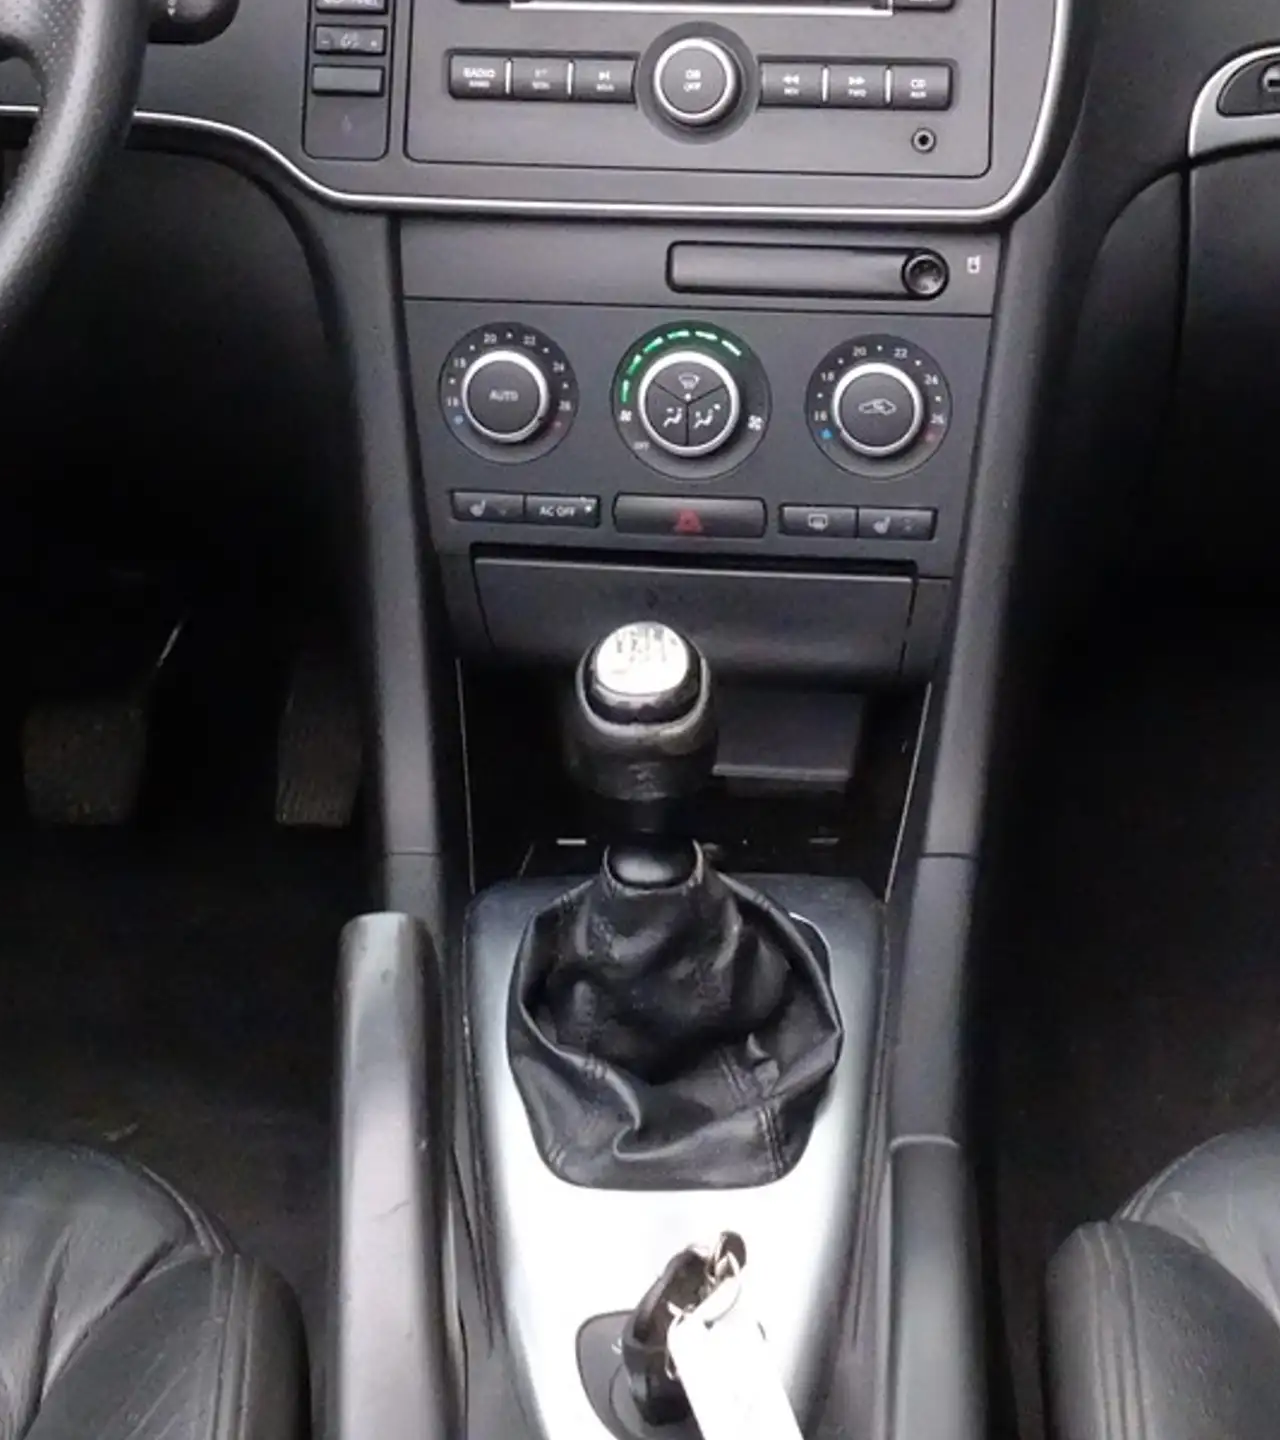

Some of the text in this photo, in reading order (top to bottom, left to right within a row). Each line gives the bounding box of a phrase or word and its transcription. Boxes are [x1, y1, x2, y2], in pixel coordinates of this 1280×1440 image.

[893, 348, 908, 358] 22
[489, 389, 519, 402] AUTO
[539, 506, 576, 518] AC OFF
